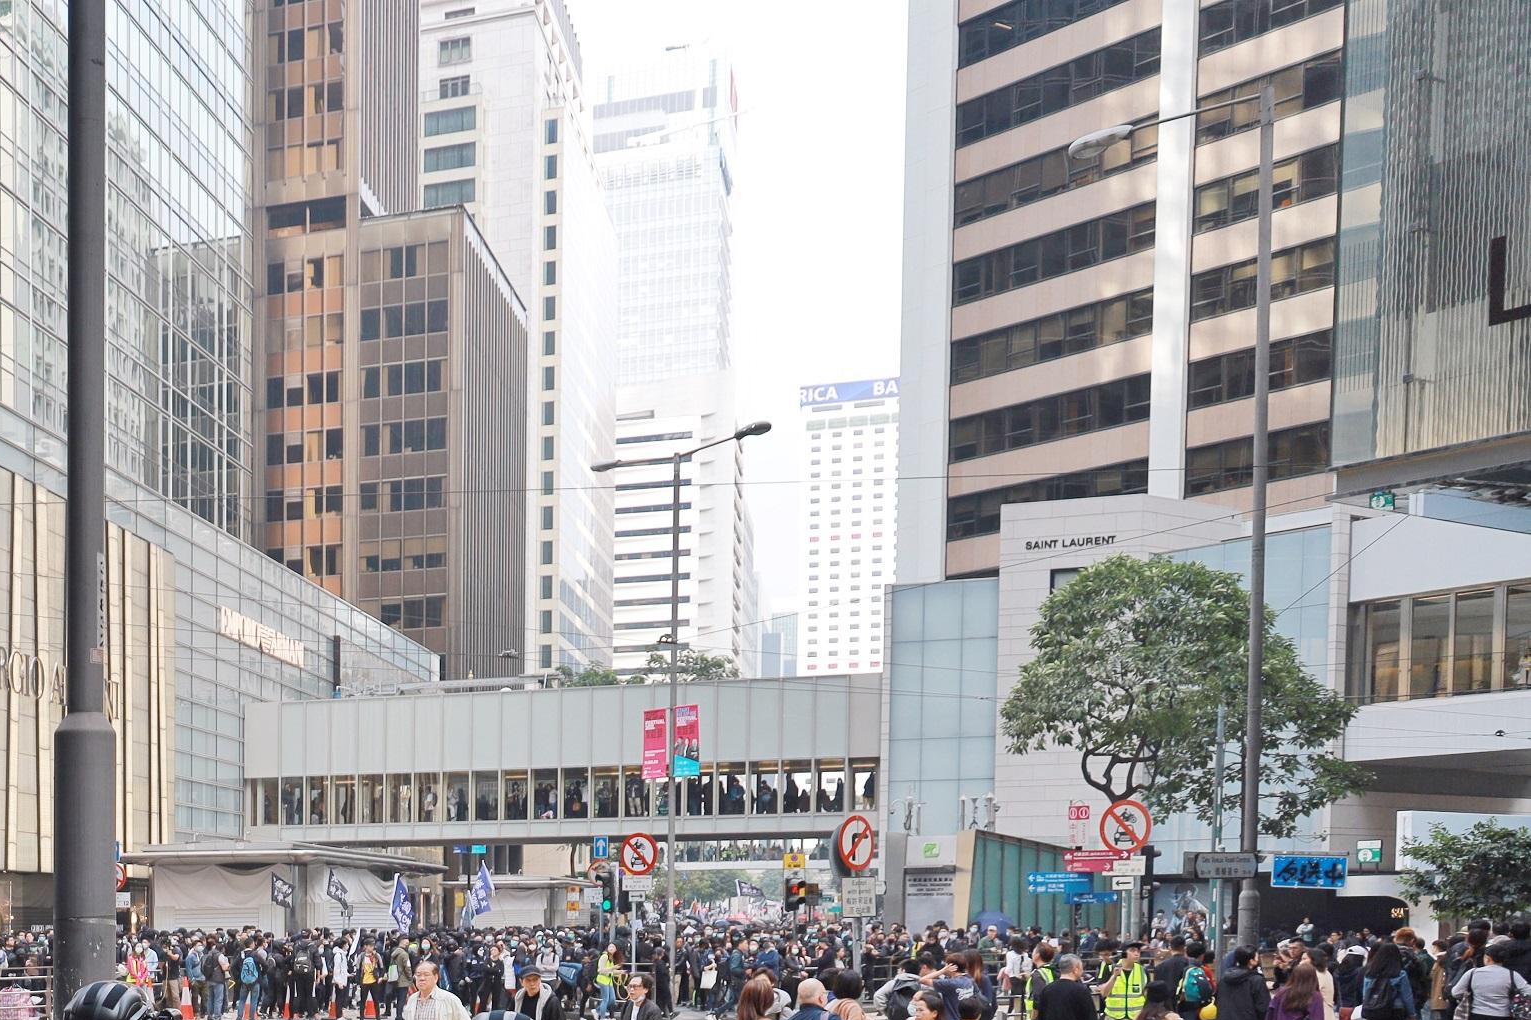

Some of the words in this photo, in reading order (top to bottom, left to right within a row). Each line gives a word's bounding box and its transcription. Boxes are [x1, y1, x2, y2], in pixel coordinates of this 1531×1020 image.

[1025, 540, 1058, 550] SAINT
[1062, 535, 1116, 548] LAURENT
[50, 661, 119, 720] ANI
